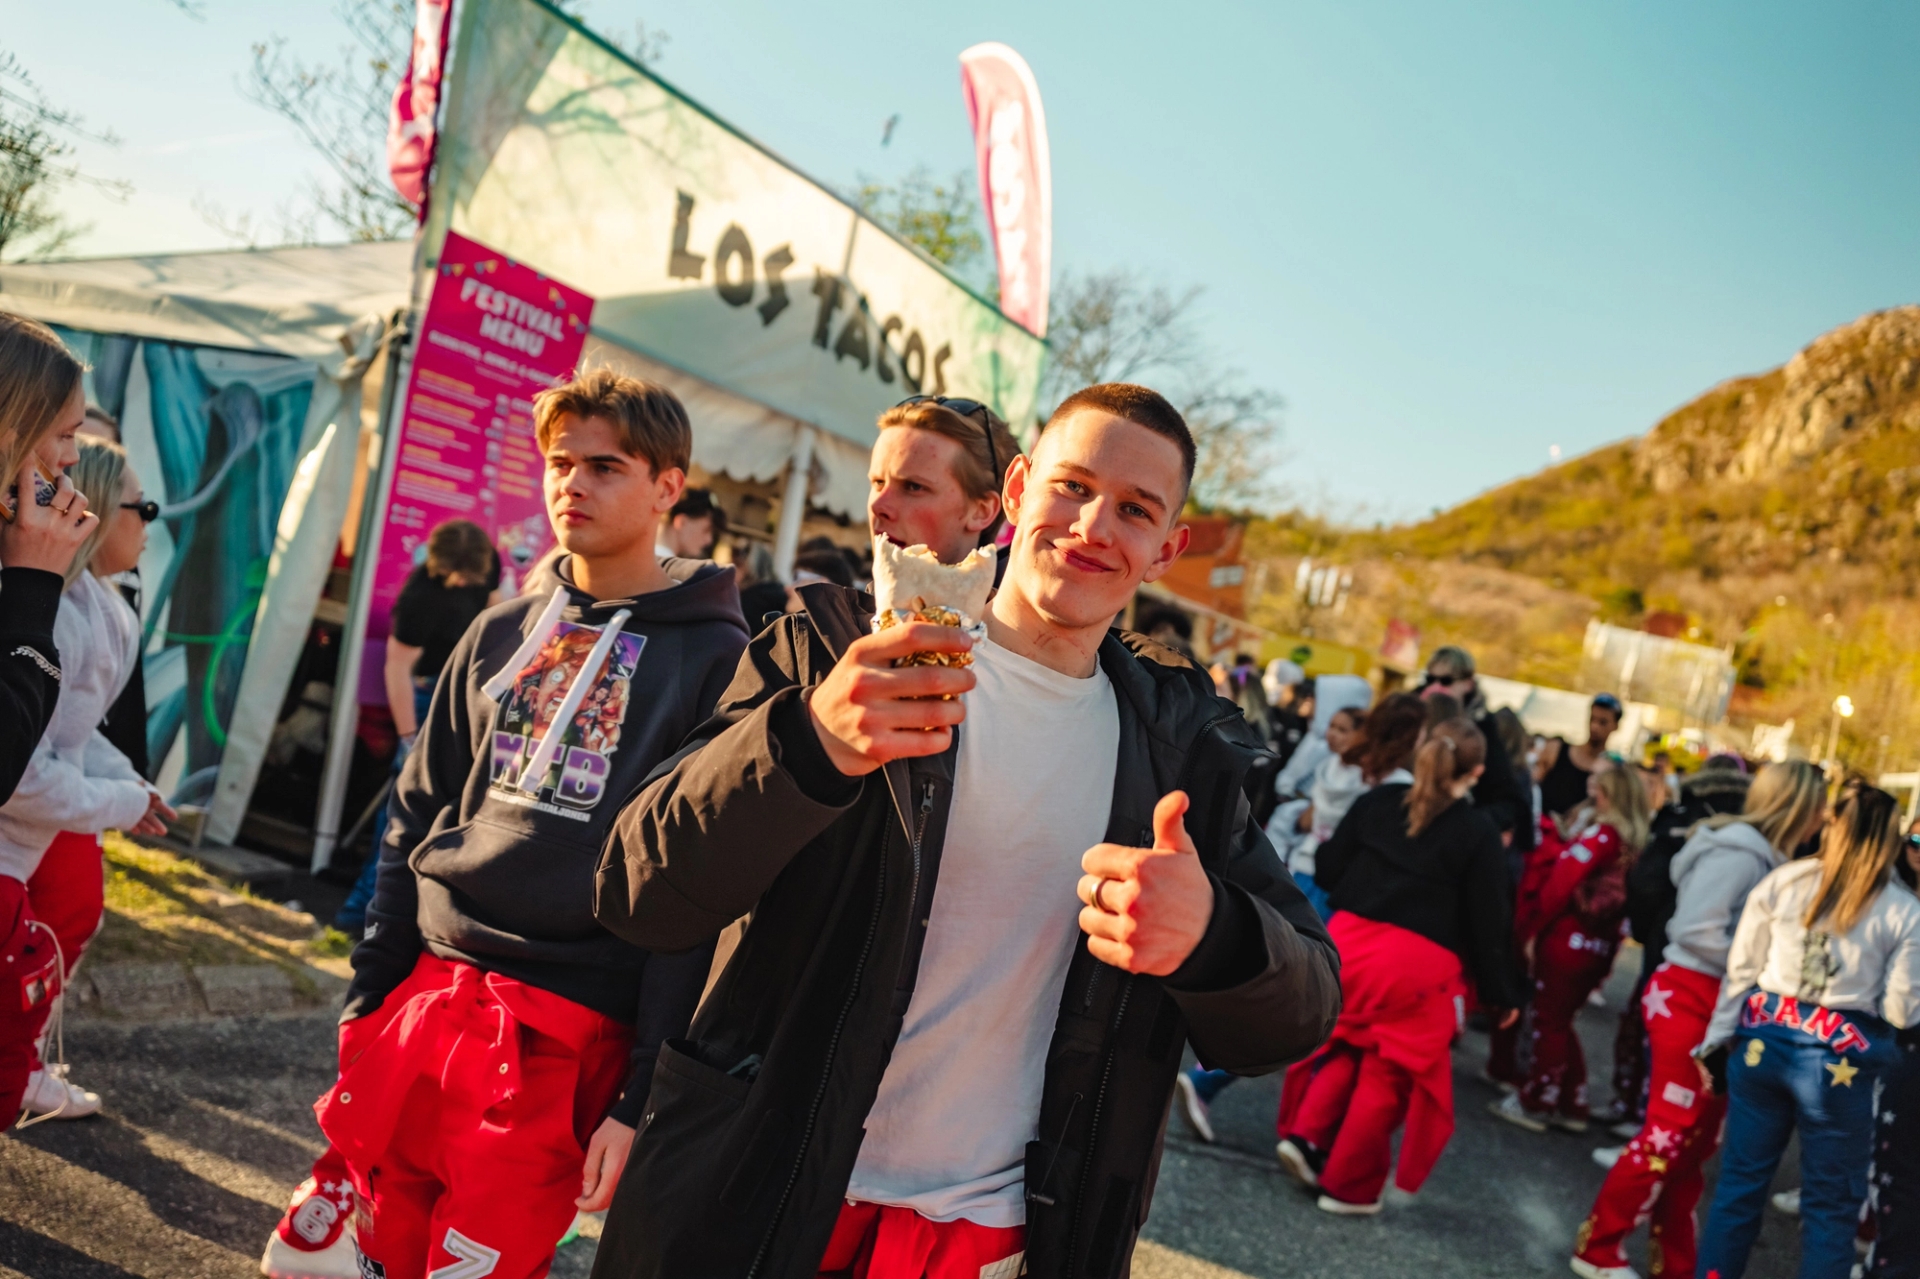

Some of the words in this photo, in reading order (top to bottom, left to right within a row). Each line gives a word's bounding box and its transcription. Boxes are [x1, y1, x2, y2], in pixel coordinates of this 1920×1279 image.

[460, 276, 565, 342] FESTIVAL
[668, 187, 795, 328] LOS
[810, 266, 952, 396] TACOS
[479, 314, 546, 358] MENU
